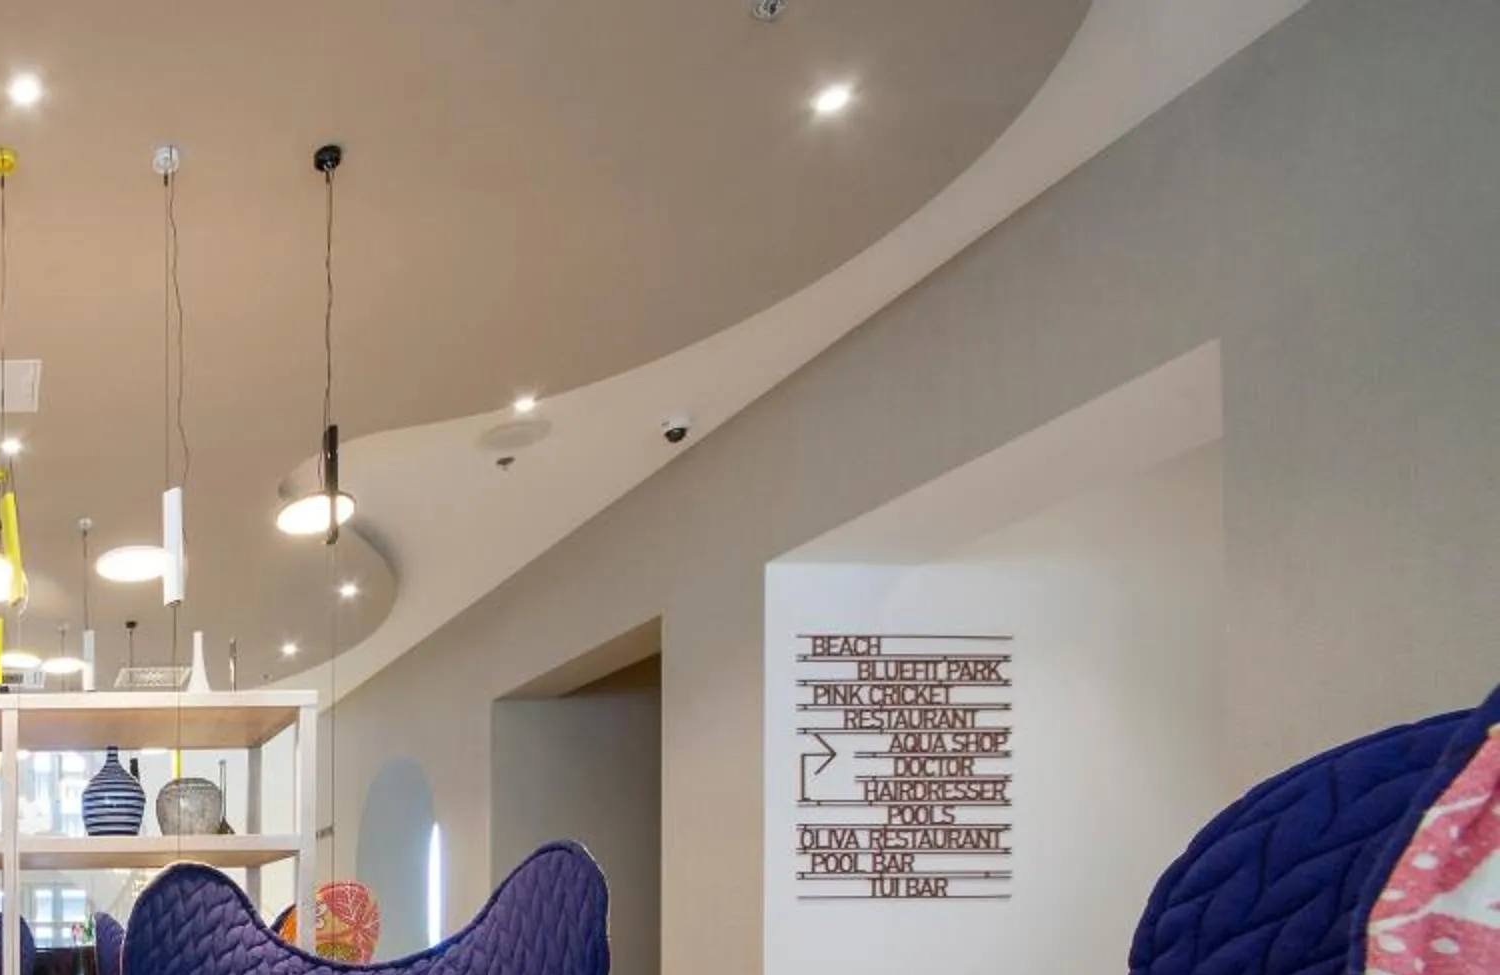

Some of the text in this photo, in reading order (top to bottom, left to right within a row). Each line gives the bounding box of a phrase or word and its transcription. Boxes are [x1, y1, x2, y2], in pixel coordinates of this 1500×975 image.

[811, 636, 881, 656] BEACH
[857, 660, 1003, 681] BLUEFIT PARK
[813, 684, 951, 705] PINK CRICKET
[843, 708, 978, 729] RESTAURANT
[889, 732, 1008, 752] AQUA SHOP
[893, 757, 975, 777] DOCTOR
[863, 781, 1007, 801] HAIRDRESSER
[887, 805, 956, 825] POOLS
[800, 828, 1002, 849] OLIVA RESTAURANT
[811, 853, 915, 873] POOL BAR
[869, 877, 949, 897] TUI BAR
